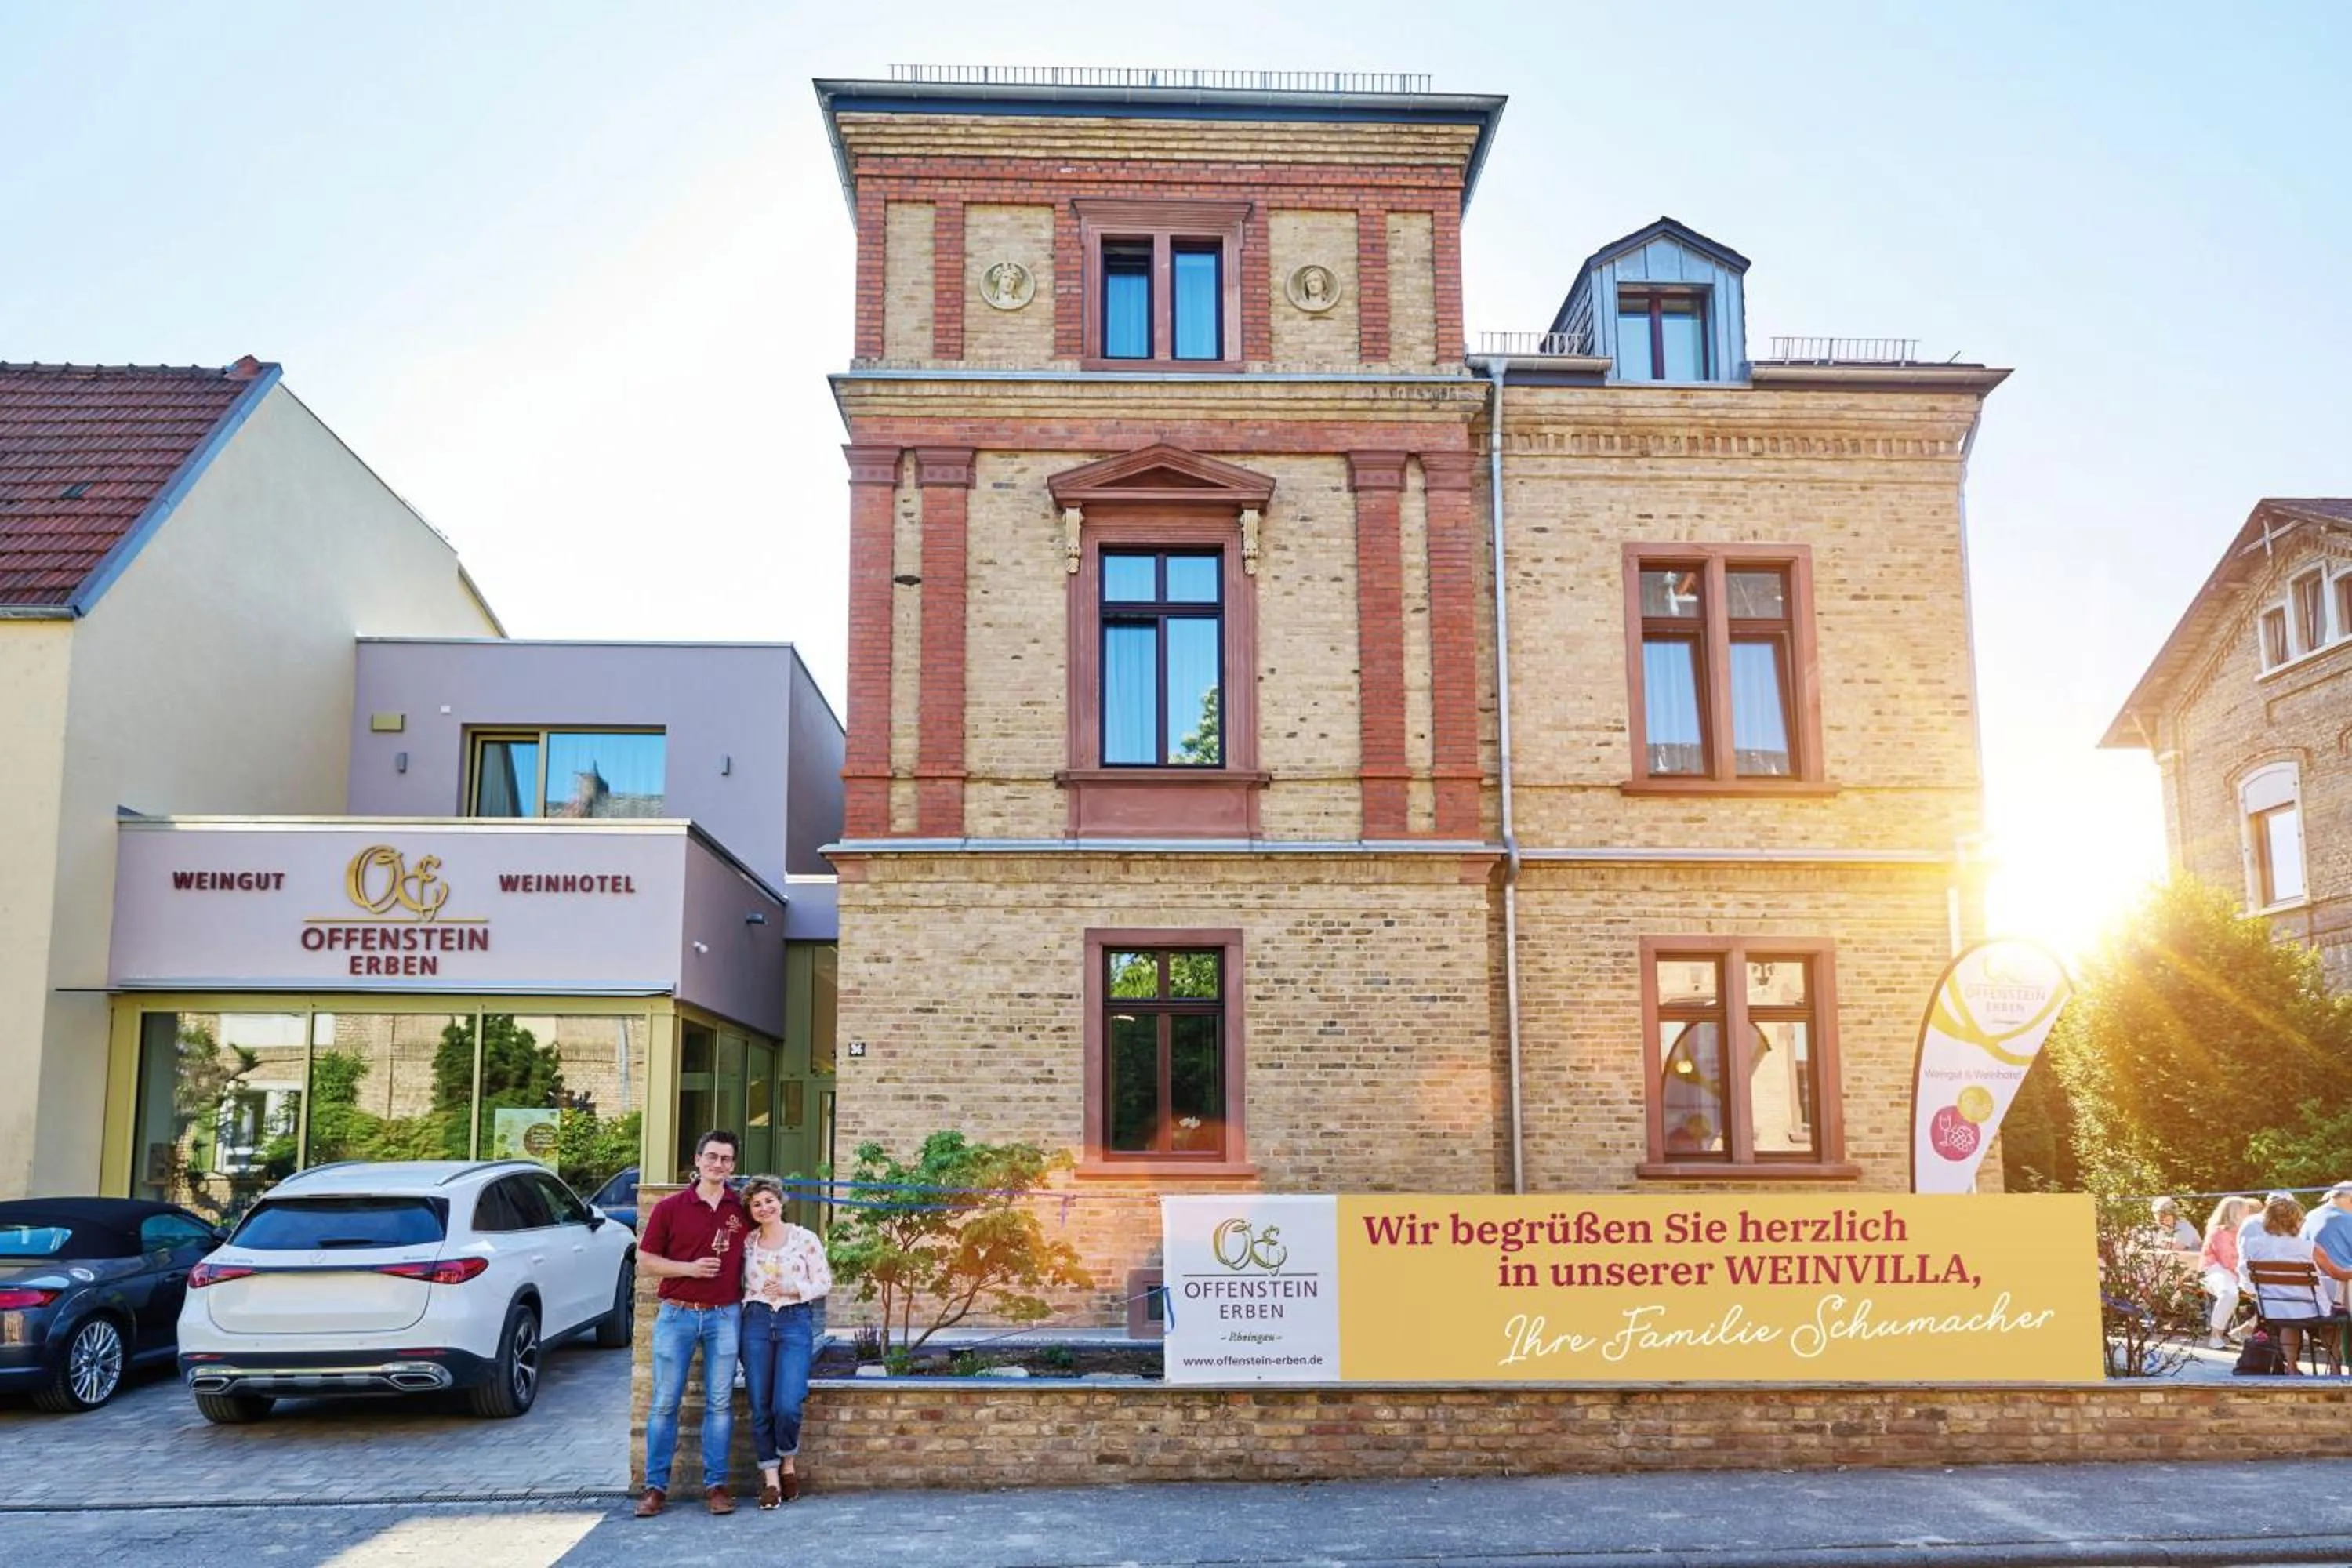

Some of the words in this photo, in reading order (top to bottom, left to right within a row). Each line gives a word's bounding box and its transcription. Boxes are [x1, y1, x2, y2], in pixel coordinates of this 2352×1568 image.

[172, 871, 285, 891] WEINGUT
[499, 873, 635, 895] WEINHOTEL
[301, 927, 490, 953] OFFENSTEIN
[349, 956, 439, 975] ERBEN
[1363, 1214, 1440, 1245] Wir
[1451, 1211, 1651, 1251] begrüßen
[1665, 1212, 1727, 1243] Sie
[1739, 1210, 1907, 1242] herzlich
[1498, 1256, 1538, 1287] in
[1550, 1259, 1714, 1286] unserer
[1725, 1254, 1982, 1290] WEINVILLA,
[1184, 1280, 1319, 1299] OFFENSTEIN
[1219, 1304, 1284, 1319] ERBEN
[1497, 1313, 1597, 1367] Ihre
[1602, 1305, 1783, 1362] Familie
[1791, 1291, 2055, 1358] Schumacher
[1183, 1355, 1323, 1366] www.offenstein-erben.de
